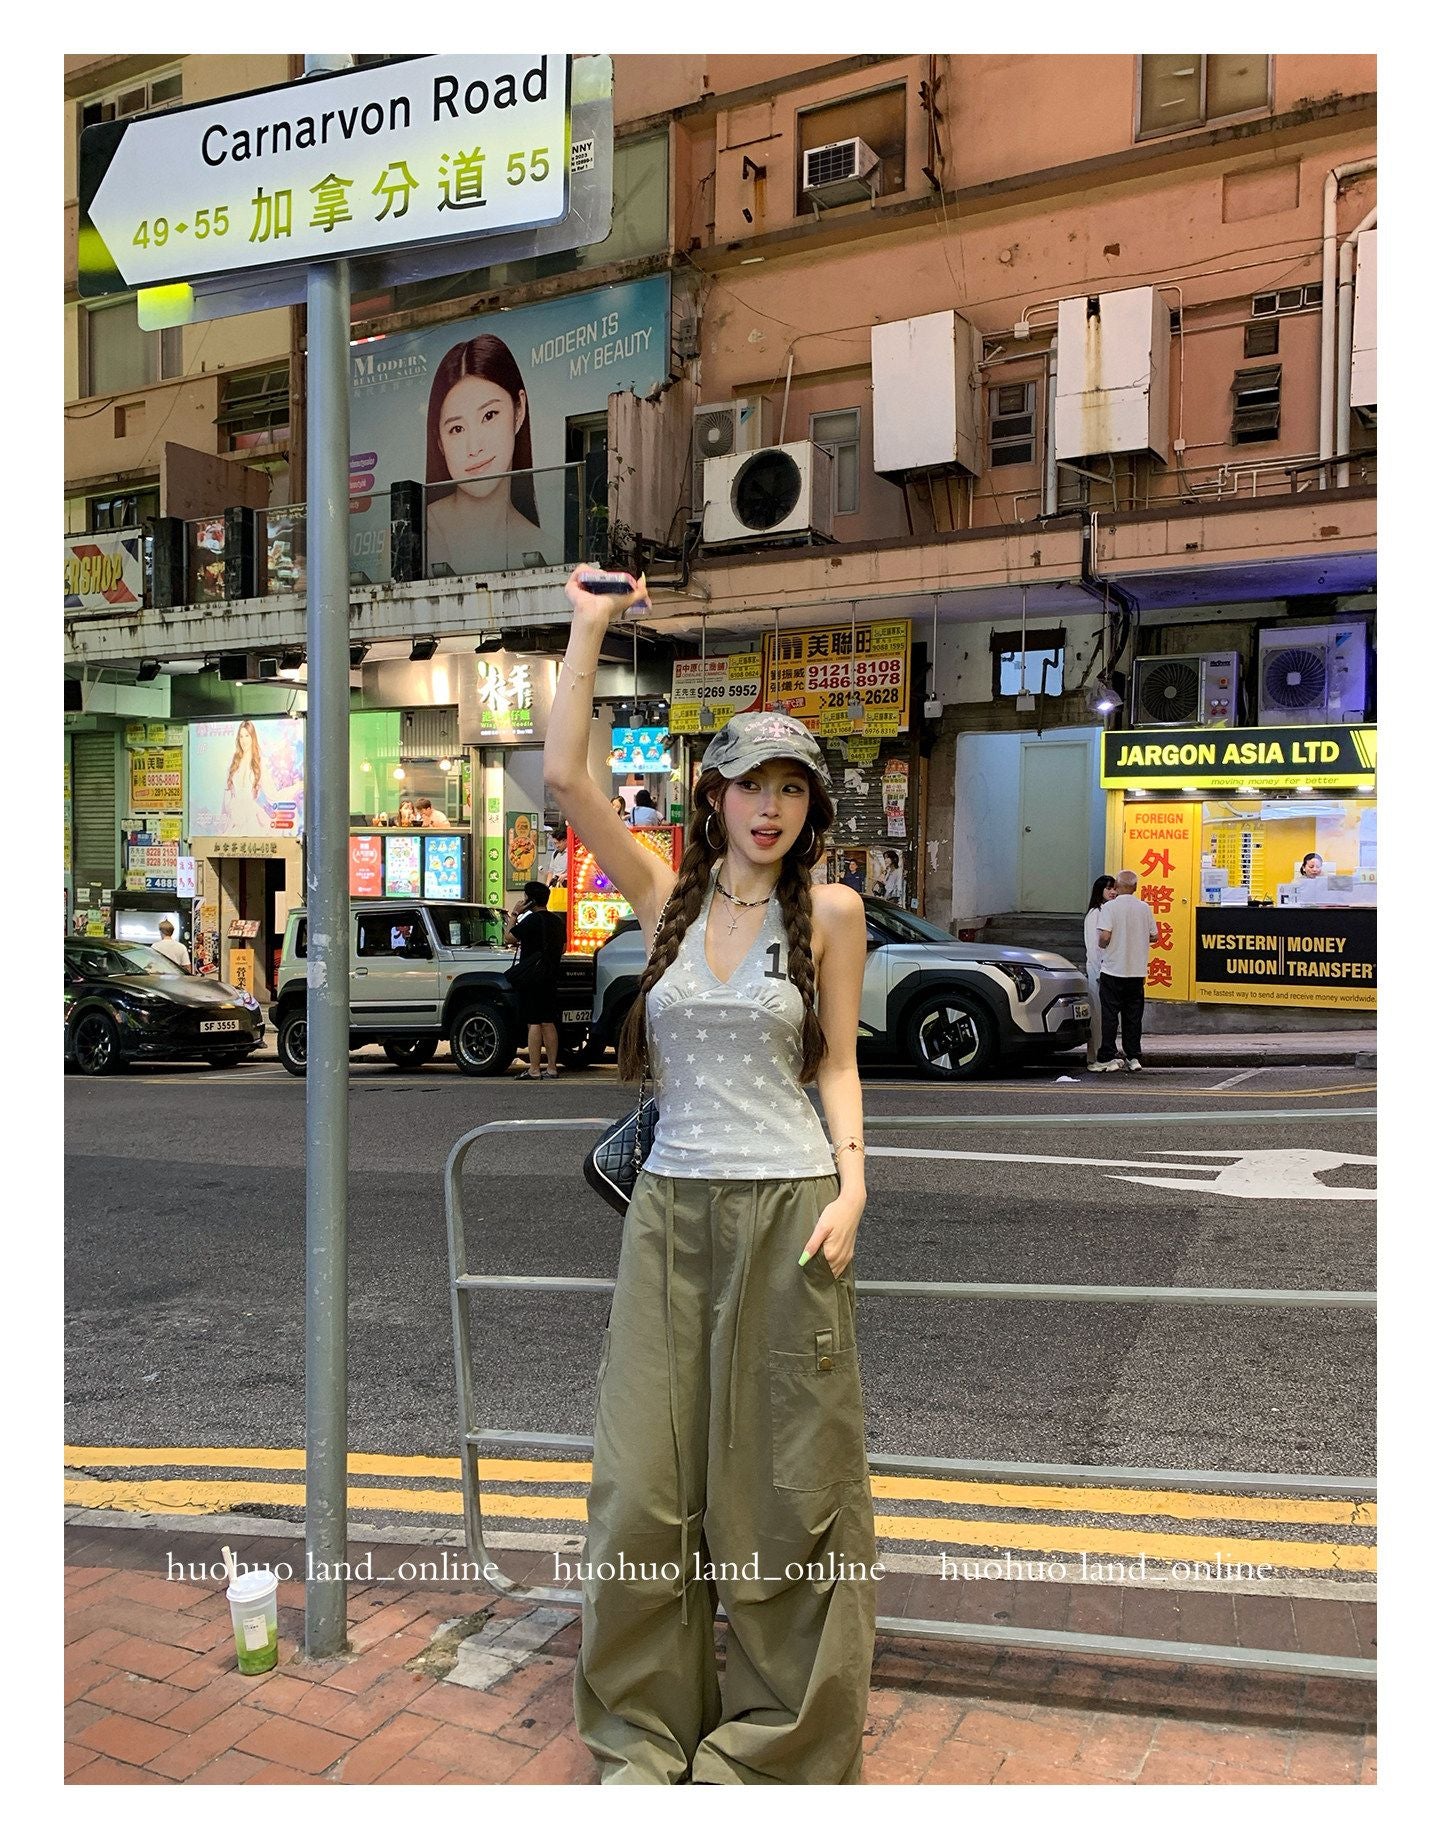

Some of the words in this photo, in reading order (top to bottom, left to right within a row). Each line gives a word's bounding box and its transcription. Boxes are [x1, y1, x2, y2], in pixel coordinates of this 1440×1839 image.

[201, 95, 411, 167] Carnarvon
[432, 54, 548, 122] Road
[132, 217, 169, 249] 49
[194, 205, 230, 240] 55
[248, 146, 488, 243] 加拿分道
[506, 147, 550, 187] 55
[530, 321, 598, 368] MODERN
[601, 312, 619, 339] IS
[569, 352, 591, 380] MY
[594, 327, 653, 370] BEAUTY
[808, 659, 901, 678] 9121-8108
[697, 686, 725, 698] 9269
[728, 684, 758, 697] 5952
[808, 672, 901, 691] 5486-8978
[1116, 743, 1216, 767] JARGON
[1222, 741, 1285, 765] ASIA
[1292, 740, 1340, 764] LTD
[1211, 778, 1244, 787] moving
[1248, 777, 1280, 787] money
[1285, 776, 1301, 785] for
[1305, 776, 1339, 785] better
[1135, 813, 1184, 824] FOREIGN
[1129, 829, 1189, 840] EXCHANGE
[1201, 934, 1277, 951] WESTERN
[1287, 936, 1346, 953] MONEY
[764, 943, 787, 981] 1
[1226, 958, 1277, 975] UNION
[1287, 960, 1373, 979] TRANSFER
[1200, 988, 1212, 996] The
[1213, 989, 1235, 997] fastest
[1236, 990, 1249, 999] way
[1250, 990, 1257, 998] to
[1258, 990, 1275, 999] send
[1276, 991, 1289, 1000] and
[1289, 992, 1314, 1001] receive
[1315, 993, 1338, 1003] money
[204, 1022, 214, 1031] SF
[217, 1021, 236, 1030] 3555
